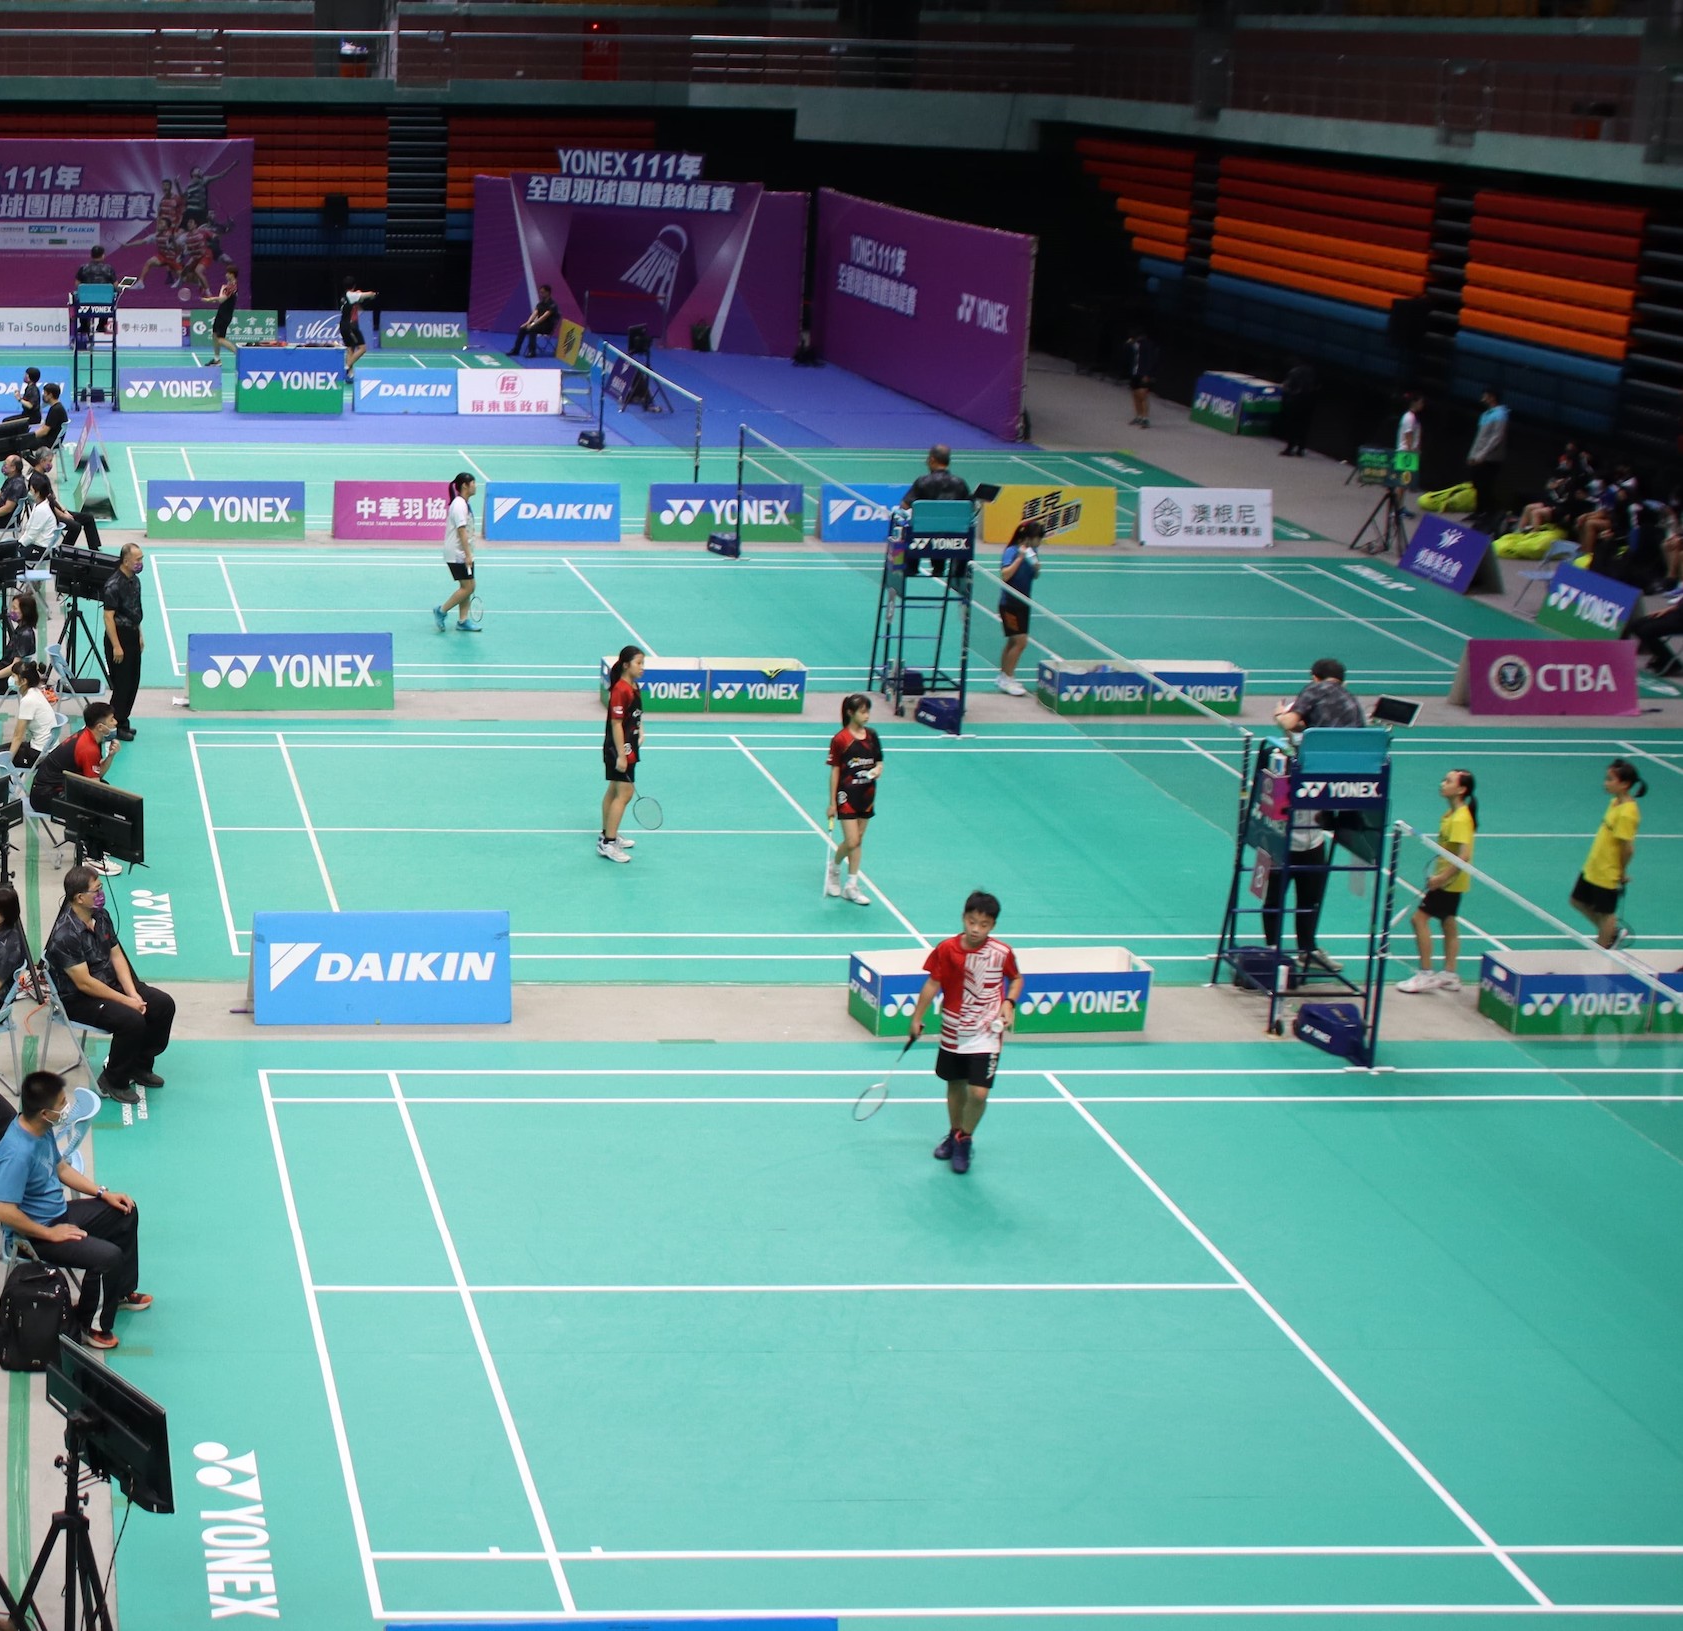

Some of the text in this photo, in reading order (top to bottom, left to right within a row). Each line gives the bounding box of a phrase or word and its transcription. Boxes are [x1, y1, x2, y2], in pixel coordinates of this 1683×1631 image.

[558, 148, 705, 181] YONEX 111年
[4, 166, 82, 190] 111年
[526, 176, 736, 212] 全國羽球團體錦標賽
[976, 297, 1010, 334] YONEX
[8, 322, 23, 332] Tai
[26, 322, 68, 332] Sounds
[121, 323, 157, 332] 零卡分期
[415, 323, 461, 338] YONEX
[159, 380, 213, 398] YONEX
[279, 372, 338, 391] YONEX
[378, 384, 452, 397] DAIKIN
[472, 400, 548, 412] 屏東縣政府
[209, 497, 291, 523] YONEX
[356, 497, 447, 520] 中華羽協
[518, 503, 613, 520] DAIKIN
[709, 500, 791, 525] YONEX
[1192, 504, 1256, 523] 澳根尼
[932, 538, 968, 550] YONEX
[1575, 583, 1625, 632] YONEX
[268, 654, 375, 688] YONEX
[1535, 664, 1617, 693] CTBA
[648, 682, 701, 699] YONEX
[746, 683, 799, 700] YONEX
[1094, 685, 1145, 701] YONEX
[1186, 686, 1238, 701] YONEX
[1328, 782, 1380, 798] YONEX
[134, 916, 177, 956] YONEX
[315, 952, 496, 981] DAIKIN
[1067, 990, 1140, 1014] YONEX
[1569, 993, 1644, 1016] YONEX
[199, 1503, 280, 1620] YONEX
